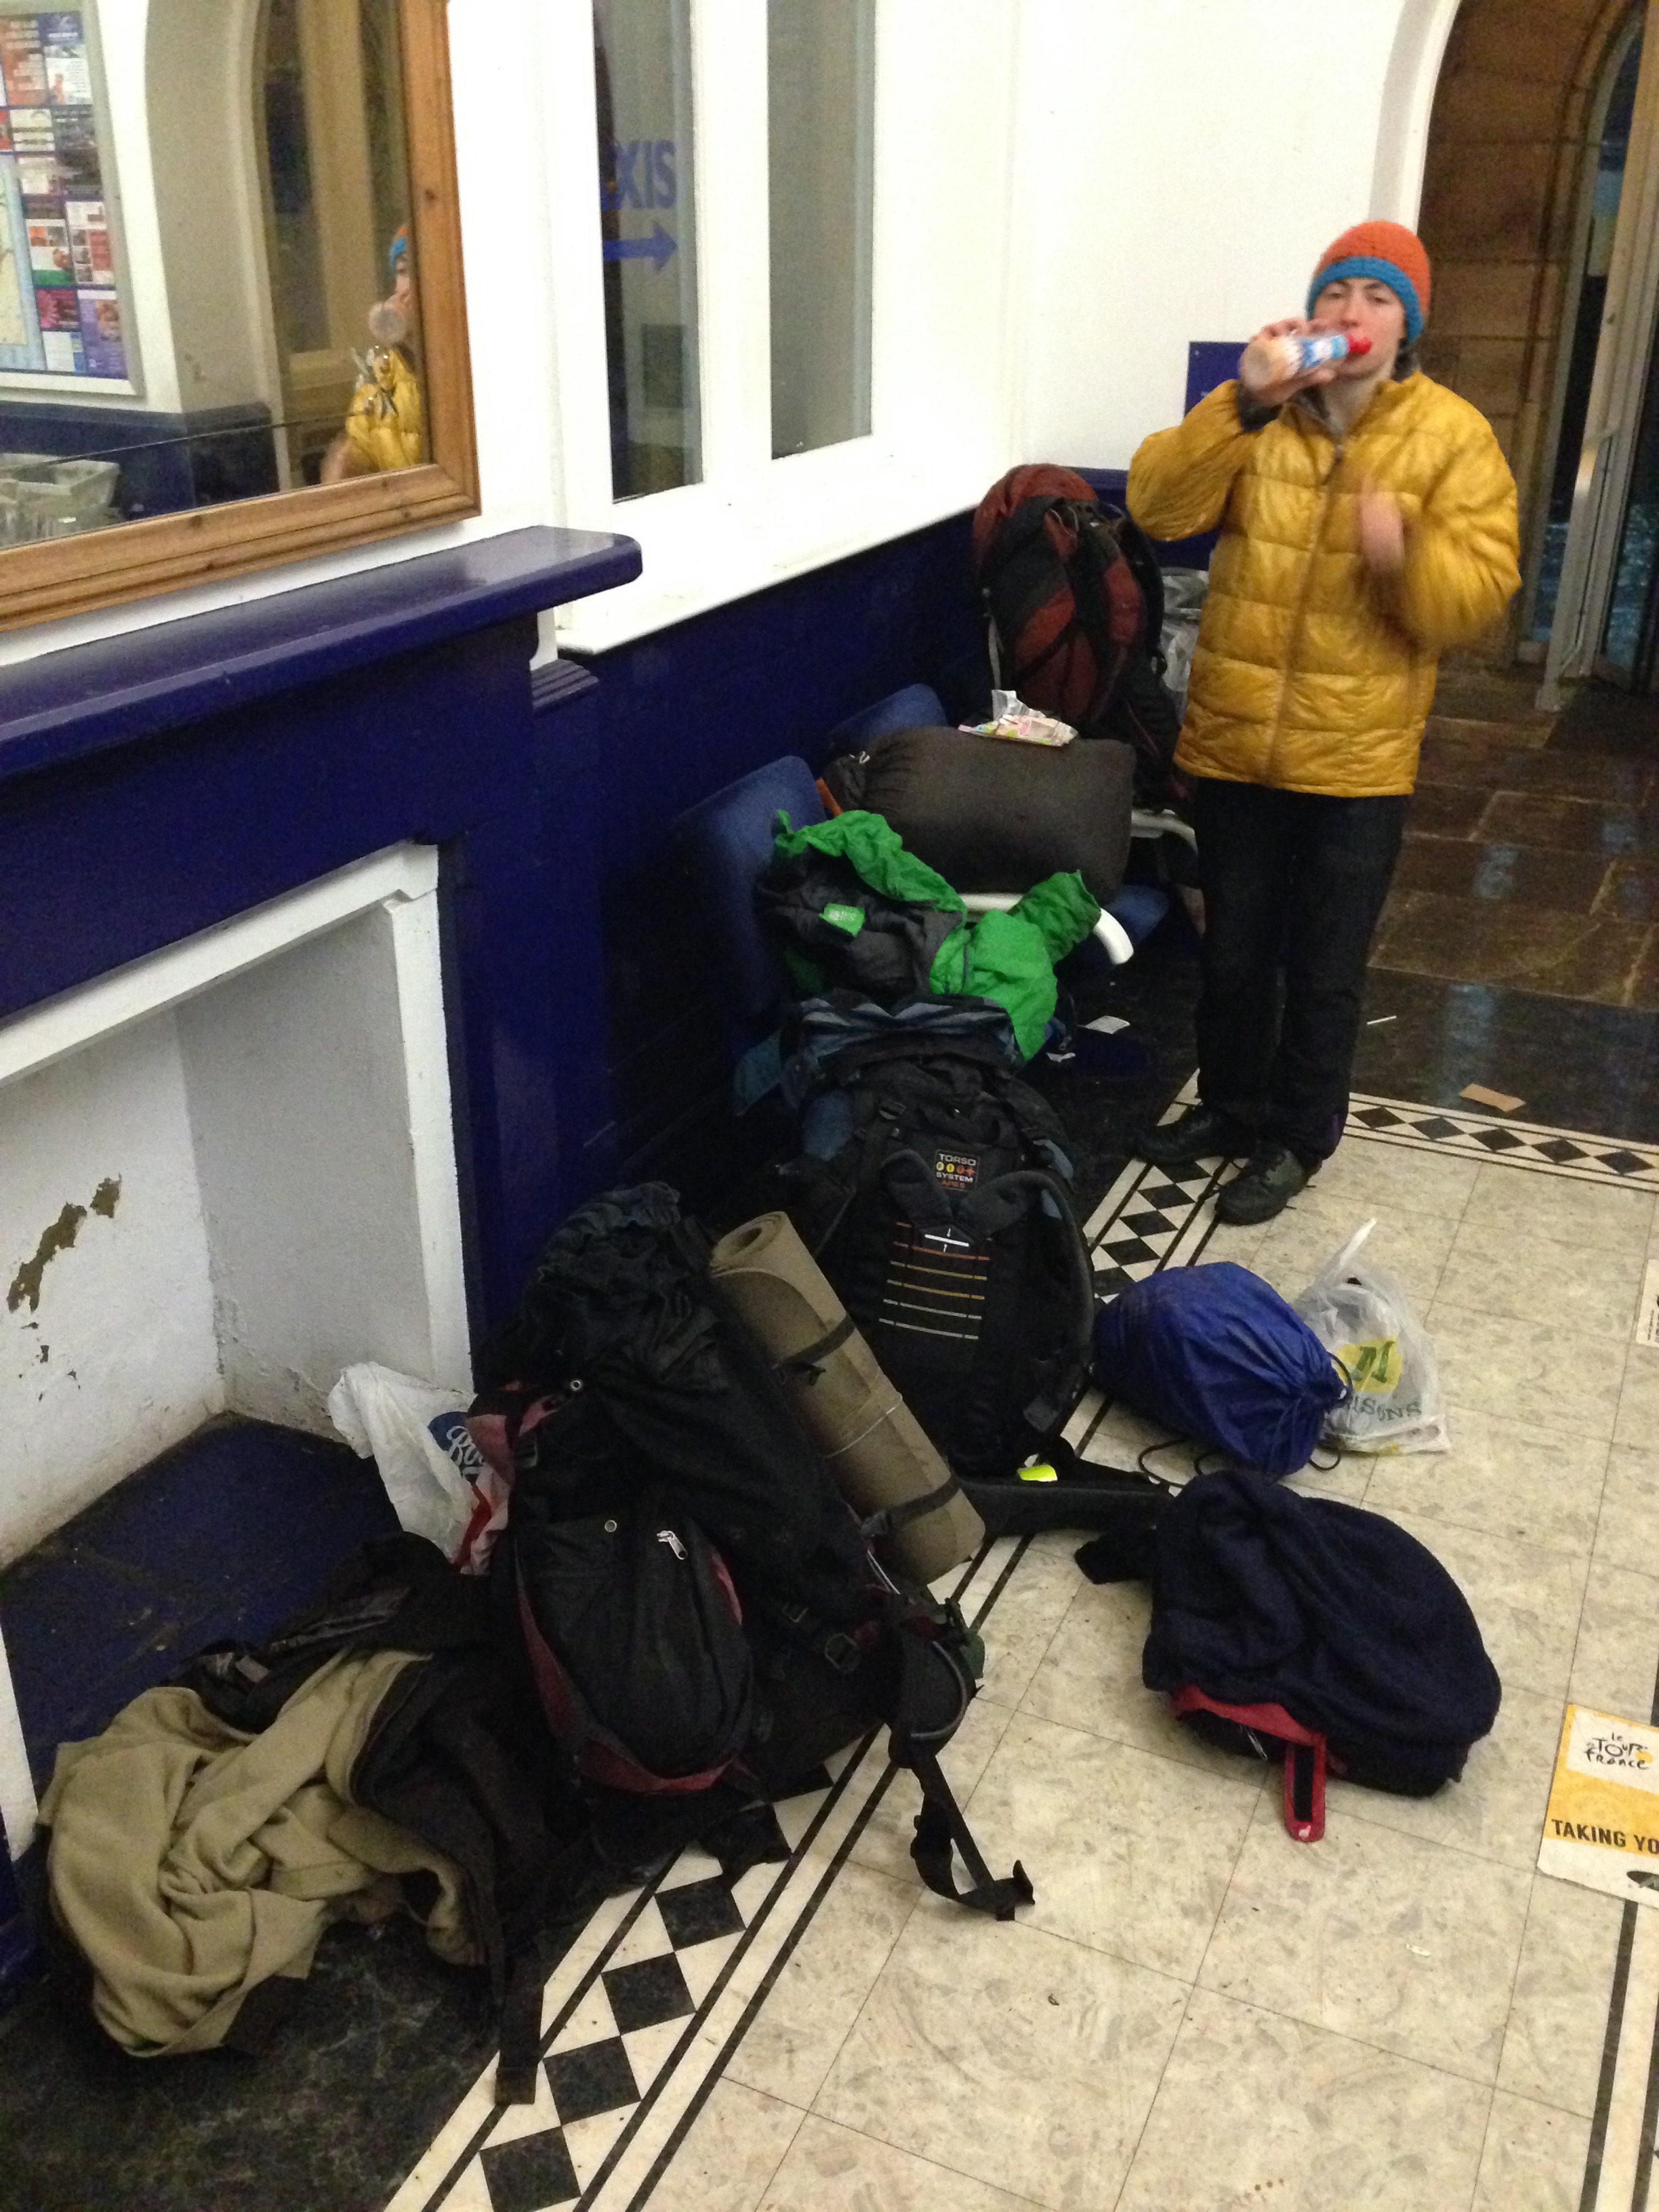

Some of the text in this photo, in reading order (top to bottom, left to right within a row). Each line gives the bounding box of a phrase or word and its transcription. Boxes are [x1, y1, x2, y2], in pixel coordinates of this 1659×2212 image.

[939, 1153, 977, 1166] TORSO
[936, 1172, 974, 1183] SYSTEM
[1551, 1819, 1626, 1847] TAKING
